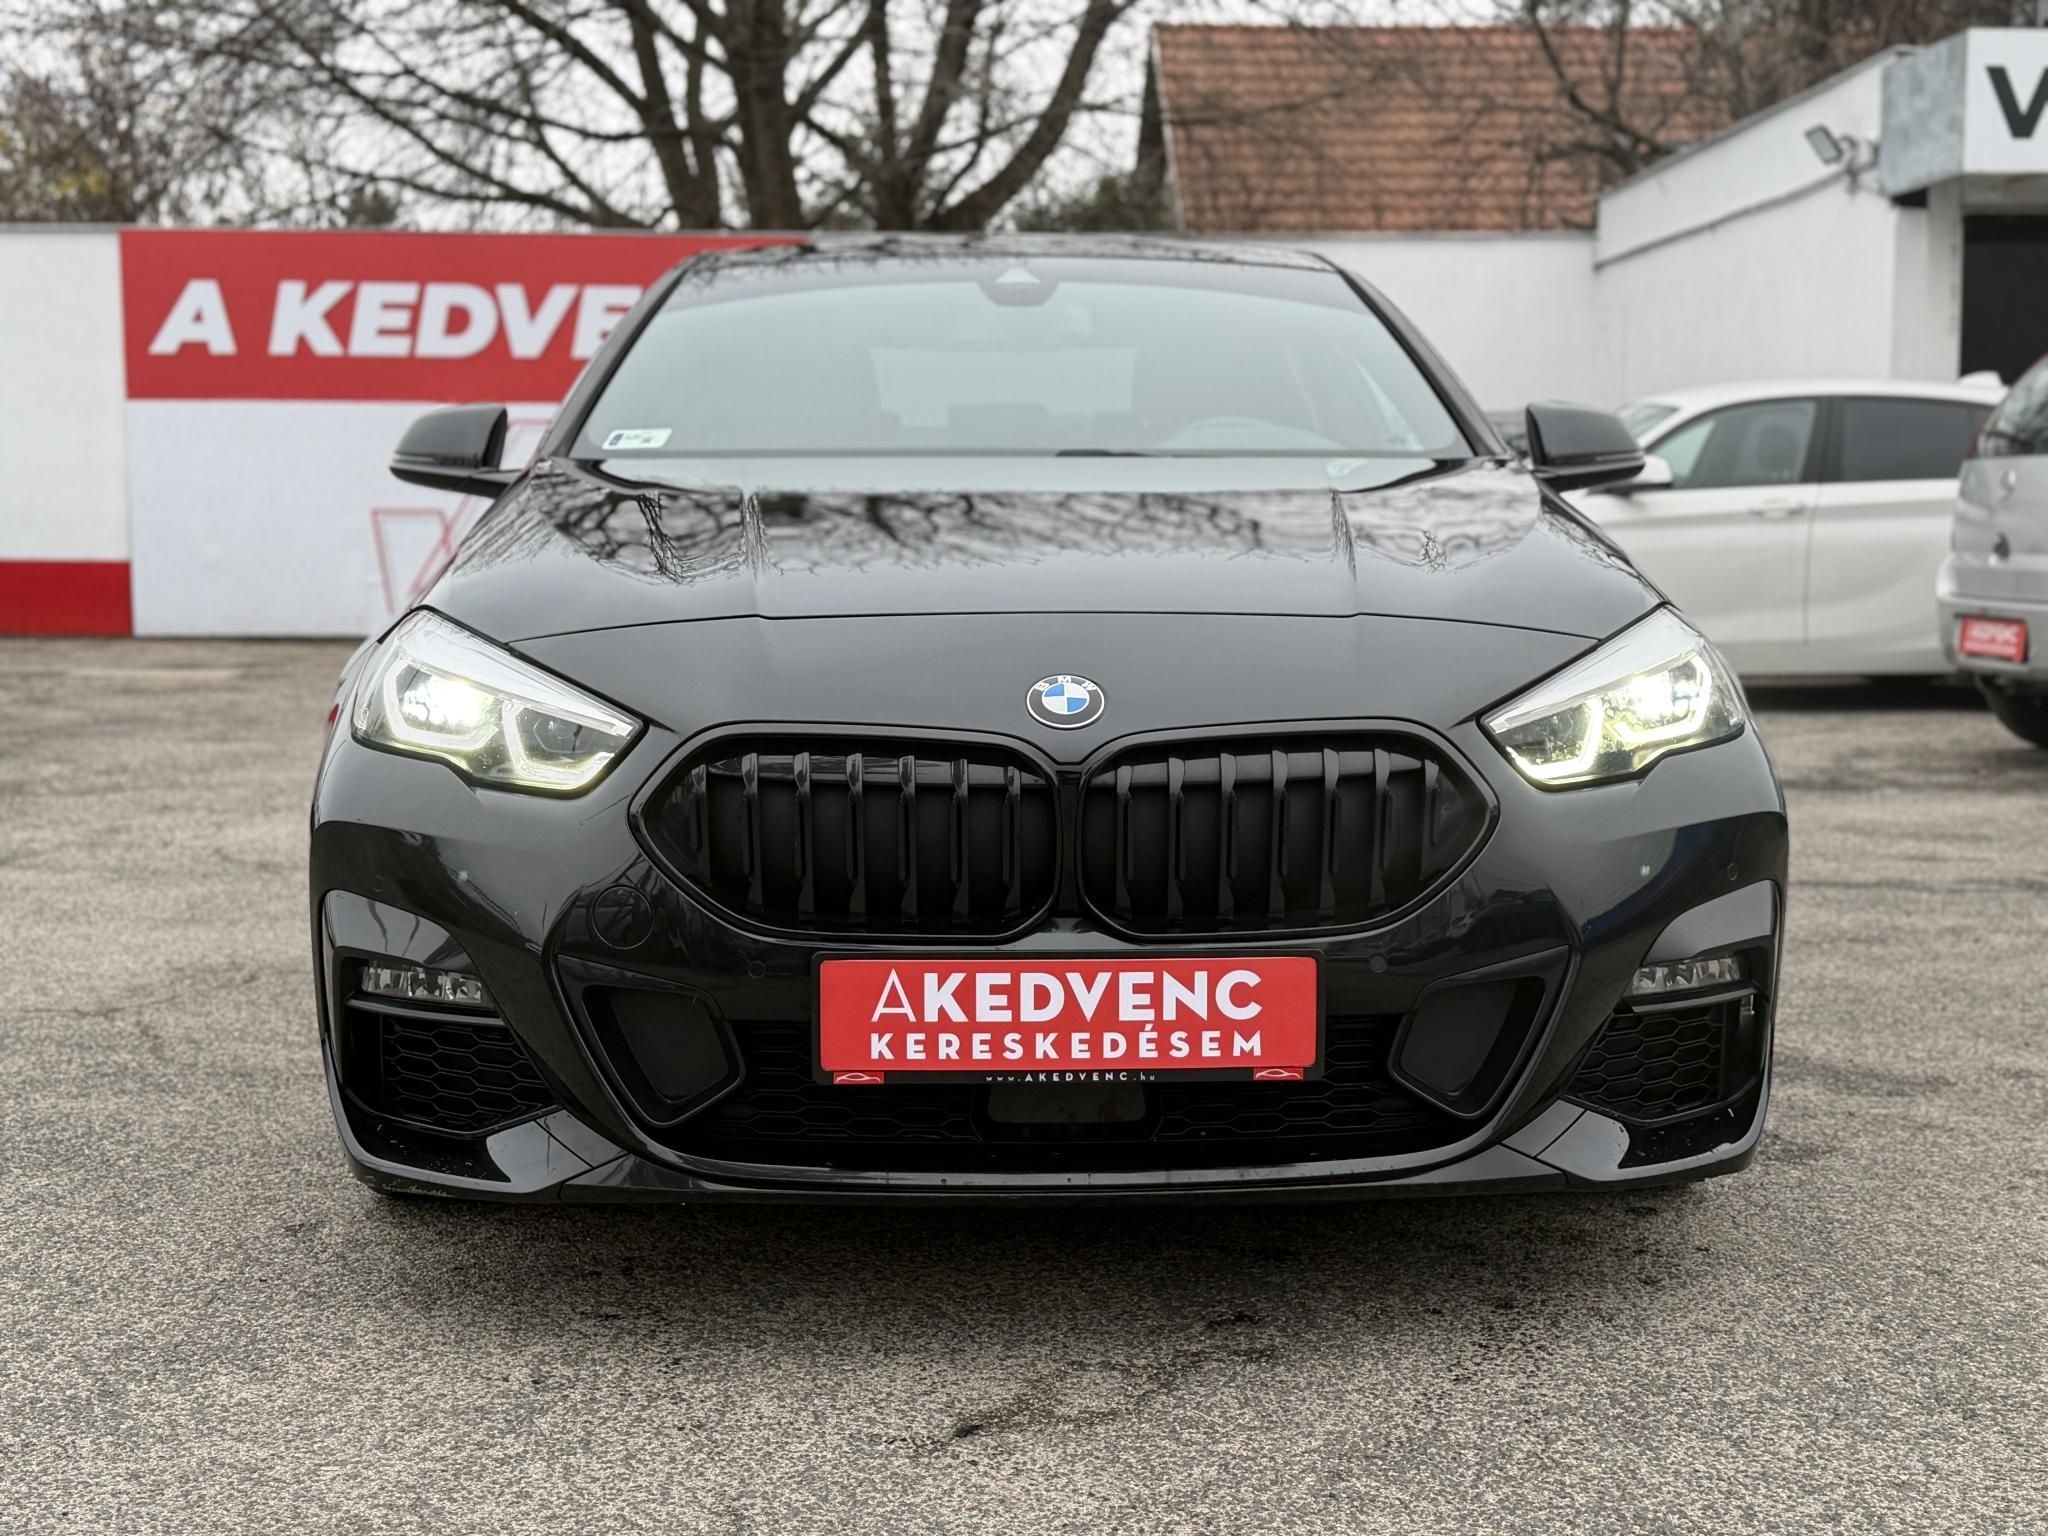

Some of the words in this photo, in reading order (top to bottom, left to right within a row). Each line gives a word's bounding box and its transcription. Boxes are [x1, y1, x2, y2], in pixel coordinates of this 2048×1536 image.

[148, 279, 237, 355] A
[268, 280, 643, 360] KEDVE
[1034, 676, 1097, 691] BMW
[871, 968, 1263, 1023] AKEDVENC
[870, 1024, 1262, 1060] KERESKEDÉSEM
[985, 1071, 1156, 1082] www.AKEDVENC.hu
